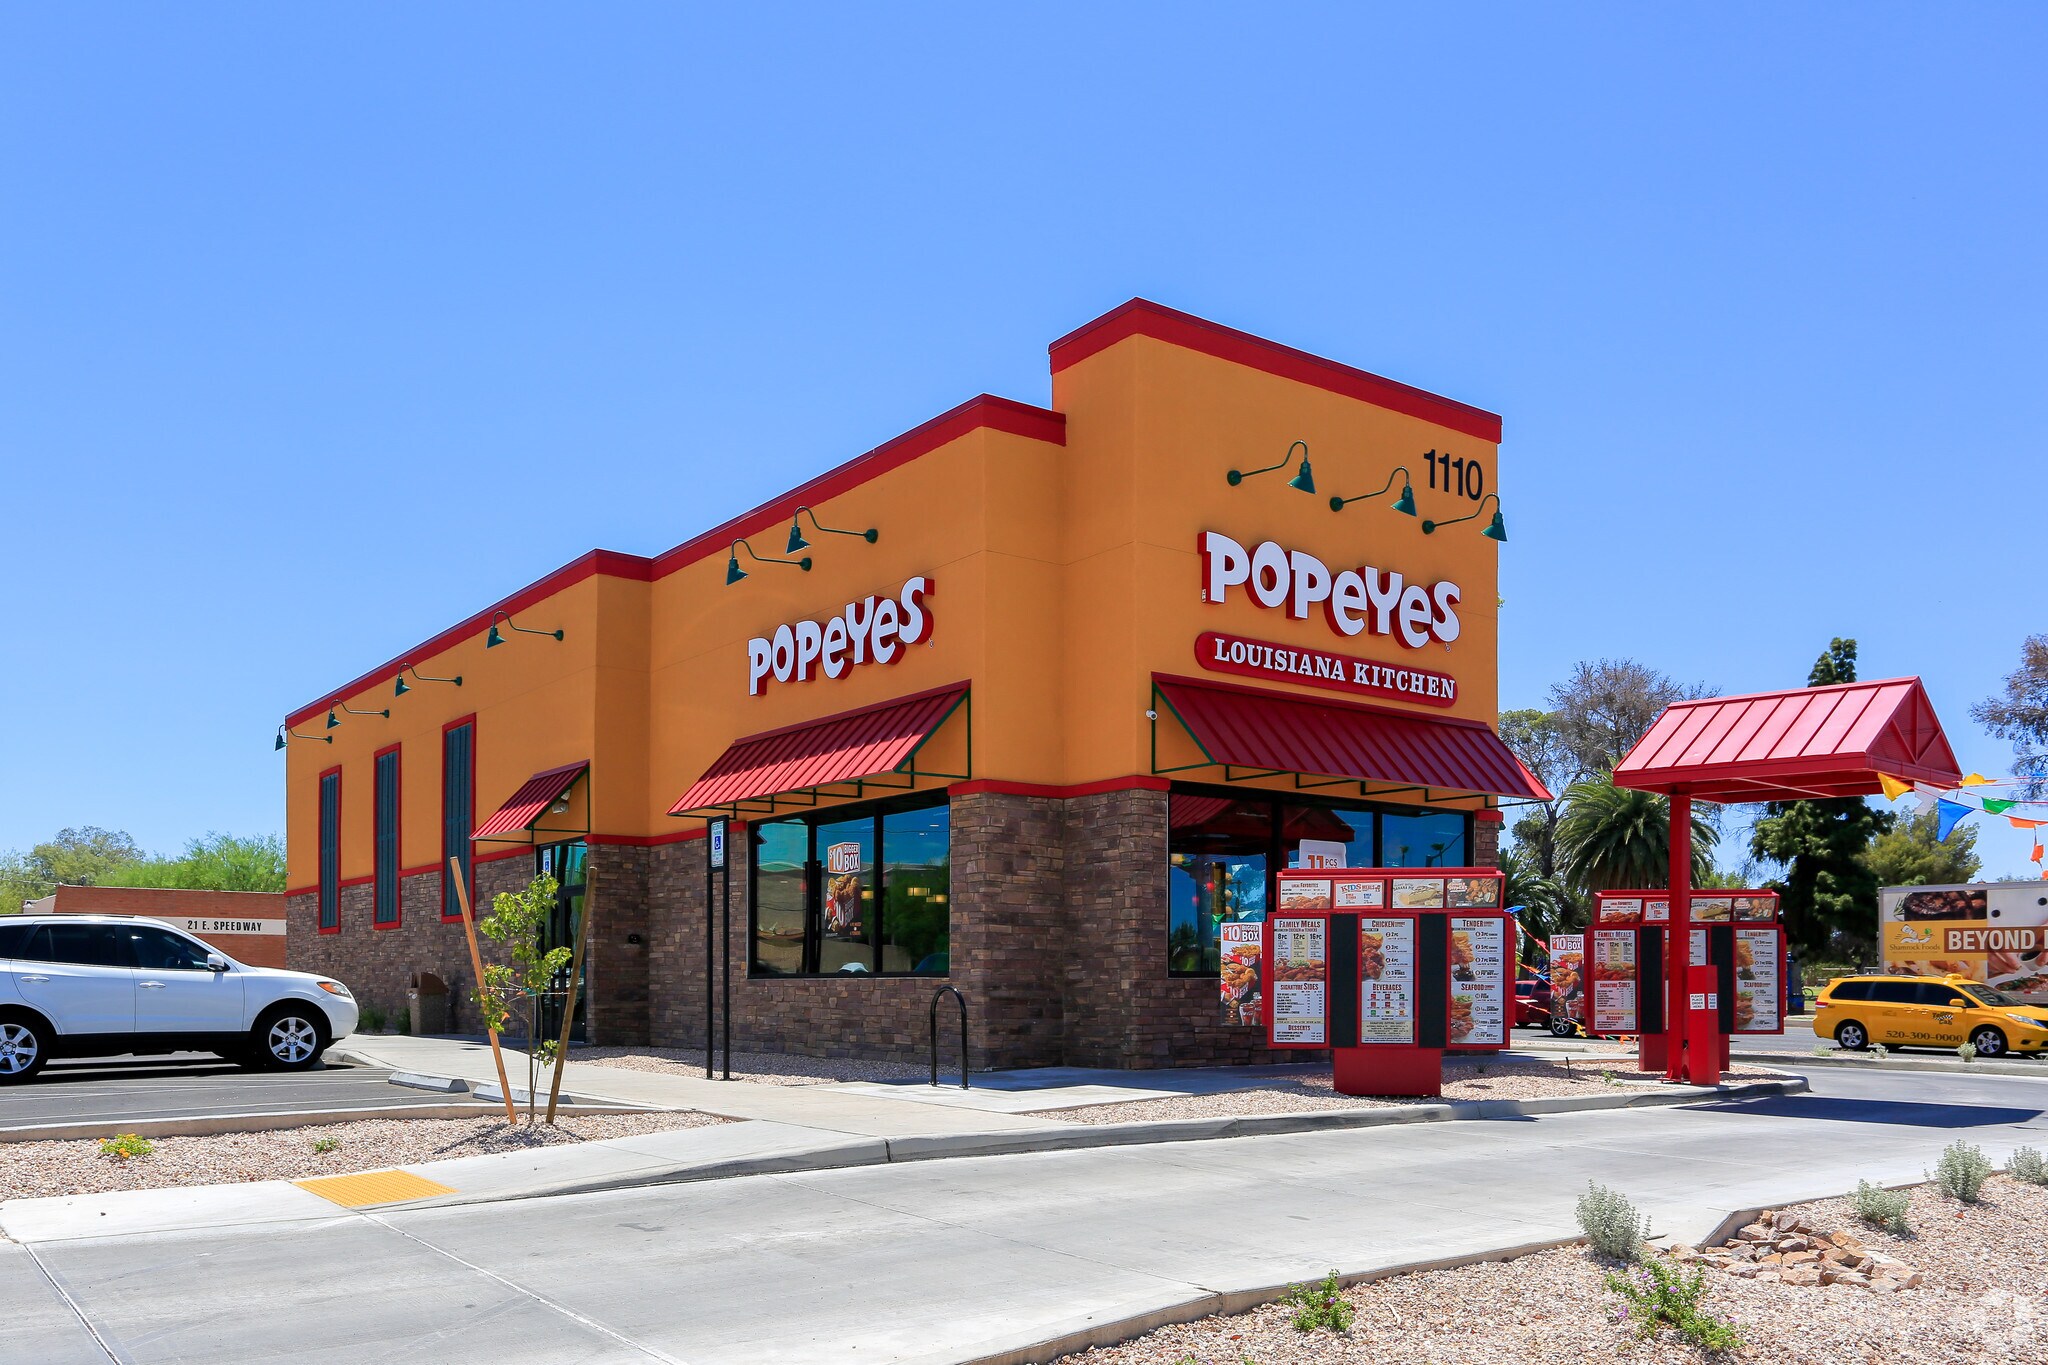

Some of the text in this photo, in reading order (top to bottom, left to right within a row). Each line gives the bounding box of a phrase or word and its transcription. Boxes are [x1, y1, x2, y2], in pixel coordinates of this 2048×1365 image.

[1423, 449, 1483, 501] 1110
[1214, 637, 1456, 699] LOUISIANA KITCHEN
[844, 854, 859, 872] BOX
[1307, 855, 1324, 869] 11
[1340, 884, 1361, 893] KIDS
[187, 920, 262, 932] 21 E. SPEEDWAY
[1279, 920, 1321, 928] FAMILY MEALS
[1371, 920, 1395, 928] CHICKEN
[1462, 919, 1484, 928] TENDER
[1224, 925, 1240, 941] $10
[1241, 931, 1259, 941] BOX
[1948, 929, 2036, 951] BEYOND
[1567, 941, 1581, 950] BOX
[1889, 943, 1941, 951] Shamrock Foods
[1303, 982, 1319, 990] SIDES
[1372, 983, 1402, 991] BEVERAGES
[1460, 982, 1485, 991] SEAFOOD
[1885, 1030, 1963, 1043] 520-300-0000
